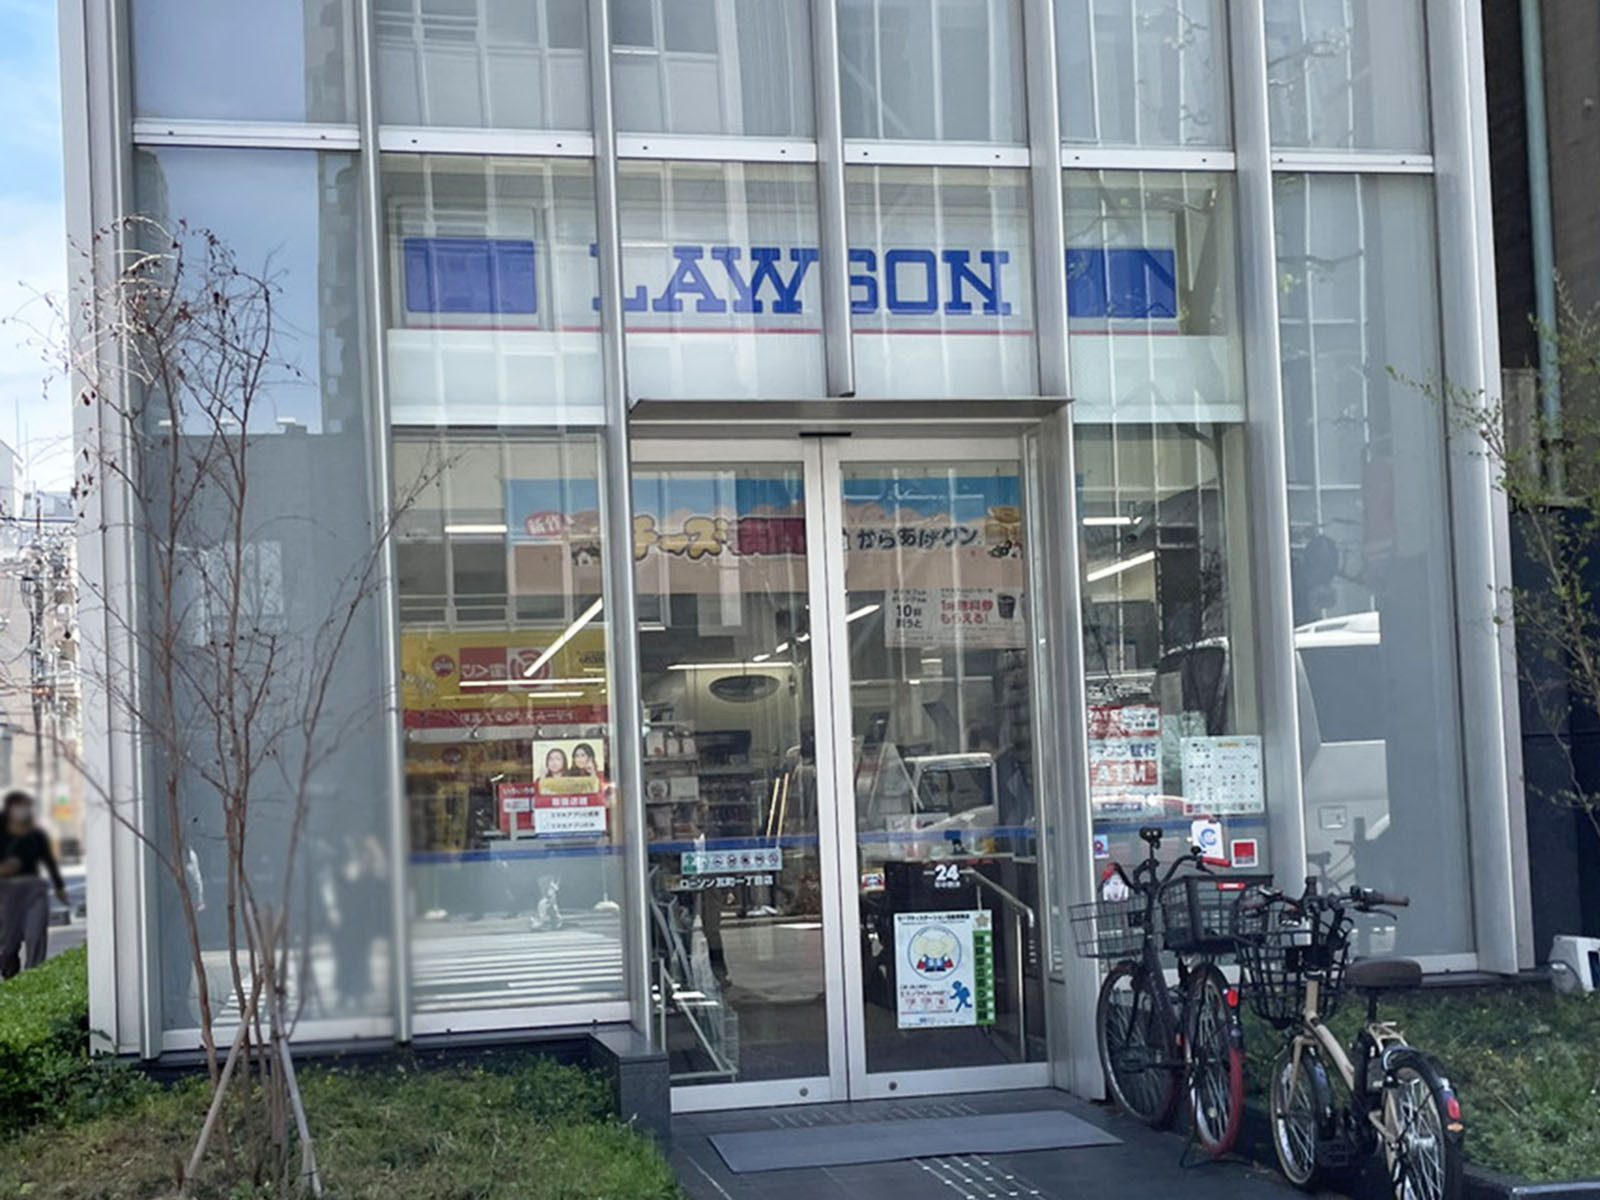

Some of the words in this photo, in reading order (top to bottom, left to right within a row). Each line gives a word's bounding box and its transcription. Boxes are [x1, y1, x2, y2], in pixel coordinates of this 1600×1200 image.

[857, 525, 977, 549] からあげクン
[1097, 763, 1146, 783] ATM
[935, 863, 960, 881] 24
